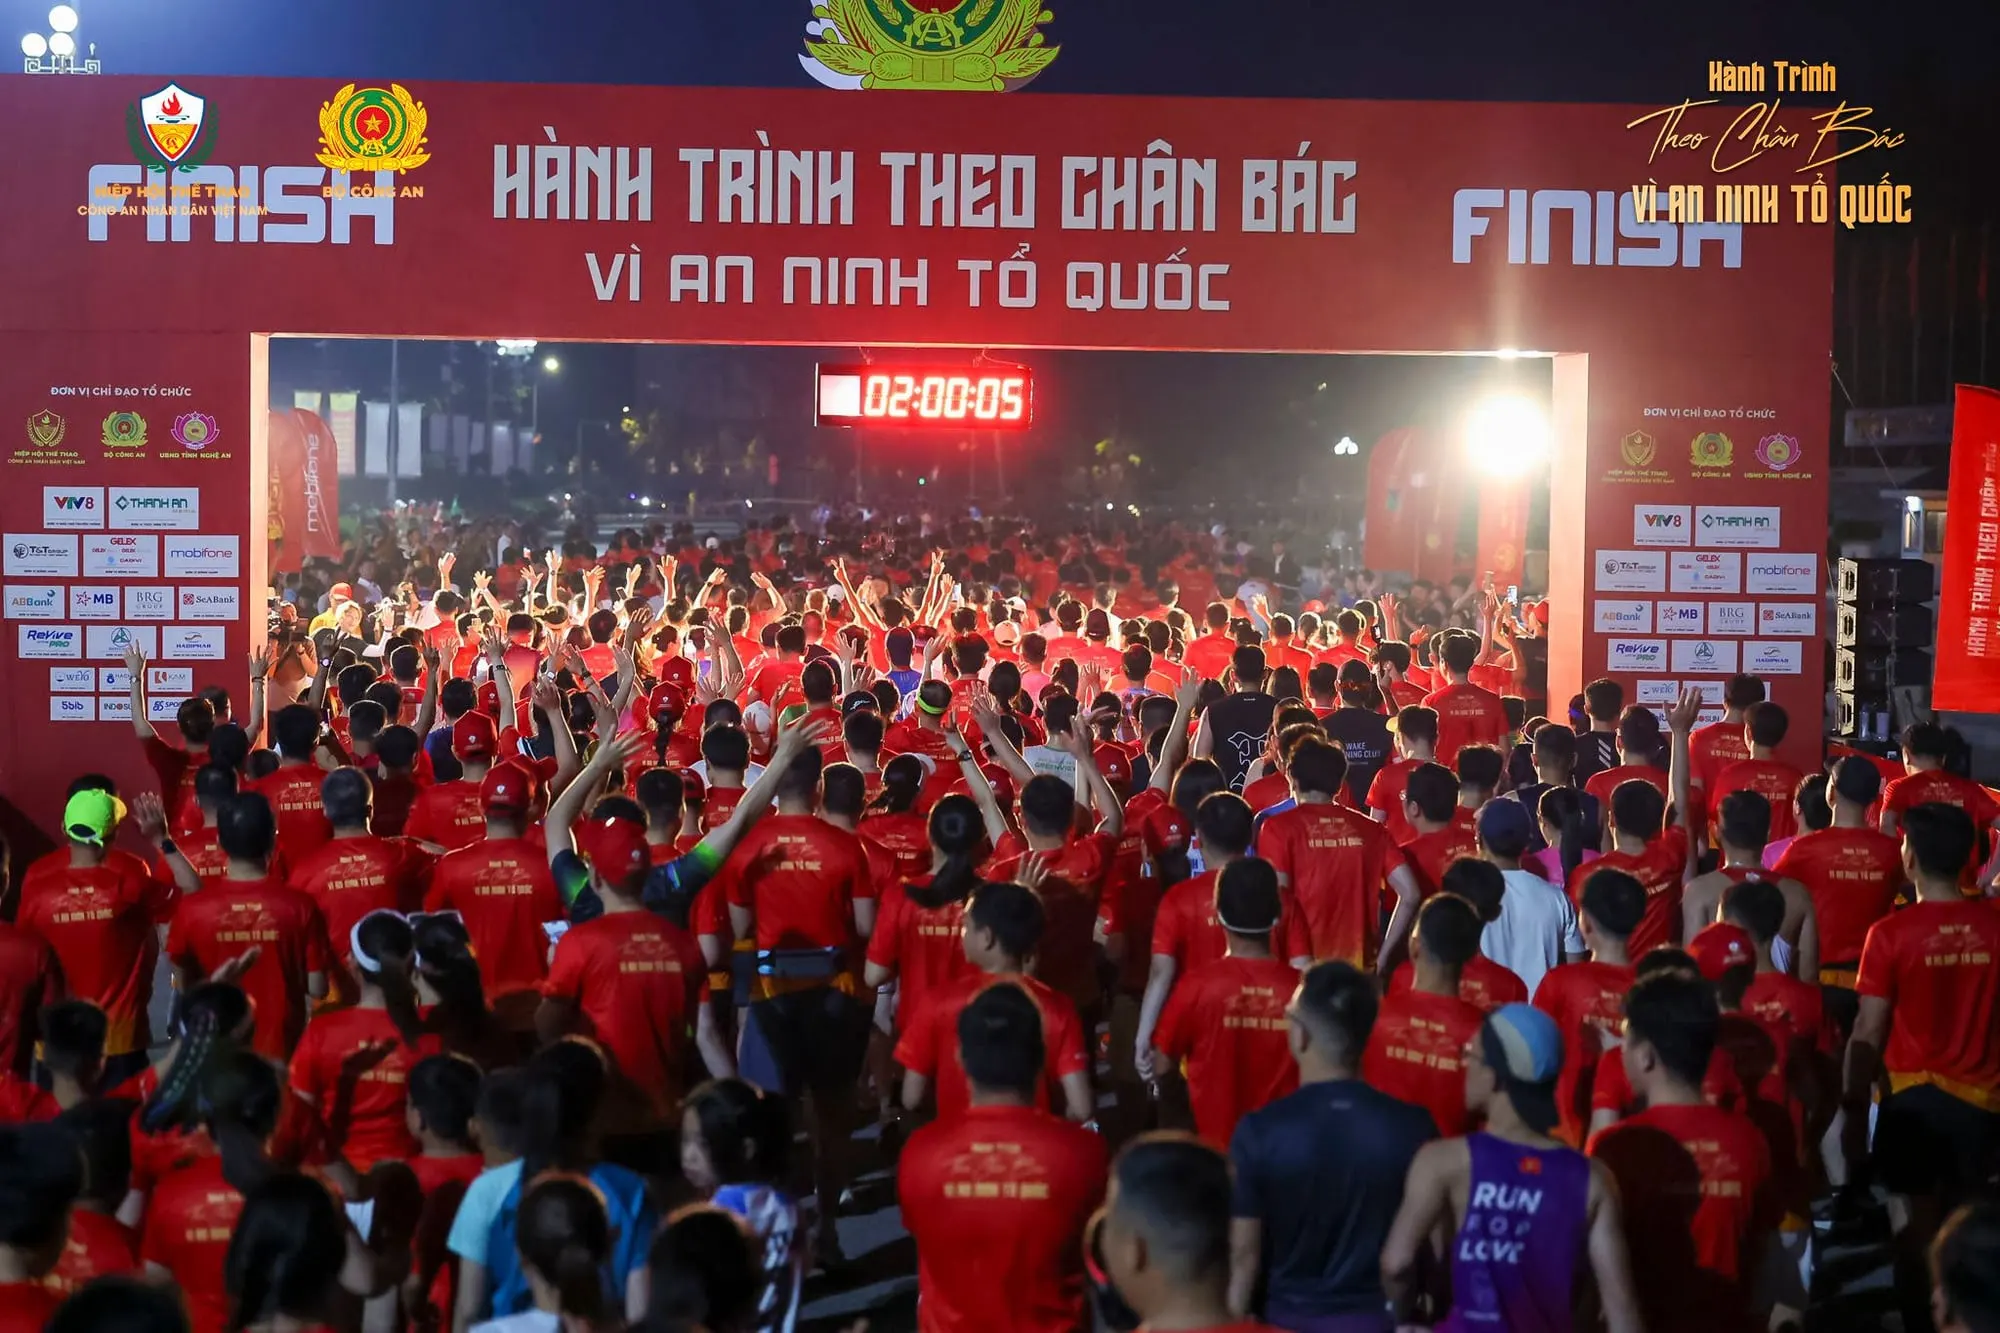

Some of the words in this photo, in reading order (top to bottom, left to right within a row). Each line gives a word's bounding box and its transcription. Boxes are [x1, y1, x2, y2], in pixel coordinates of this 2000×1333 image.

[493, 125, 652, 221] HÀNH
[678, 129, 854, 225] TRÌNH
[880, 152, 1036, 229] THEO
[1061, 138, 1217, 232] CHÂN
[1241, 141, 1357, 233] BÁC
[87, 164, 395, 245] FINISH
[1452, 188, 1744, 268] FINISH
[585, 243, 641, 301] VÌ
[669, 254, 754, 303] AN
[783, 256, 928, 306] NINH
[957, 243, 1036, 307] TỔ
[1066, 247, 1231, 312] QUỐC
[50, 386, 77, 397] ĐƠN
[78, 386, 90, 398] VỊ
[114, 386, 139, 398] ĐẠO
[160, 385, 192, 397] CHỨC
[864, 374, 1025, 420] 02:00:05
[304, 433, 320, 532] mobifone
[53, 496, 94, 510] VTV8
[130, 498, 169, 509] THANH
[171, 498, 188, 509] AN
[1644, 514, 1682, 527] VTV8
[110, 537, 137, 546] GELEX
[170, 547, 233, 559] mobifone
[1752, 565, 1811, 577] mobifone
[93, 593, 114, 605] MB
[136, 591, 163, 603] BRG
[196, 595, 235, 604] SeABank
[1678, 608, 1698, 620] MB
[1719, 607, 1744, 618] BRG
[49, 640, 70, 648] PRO
[1472, 1181, 1543, 1215] RUN
